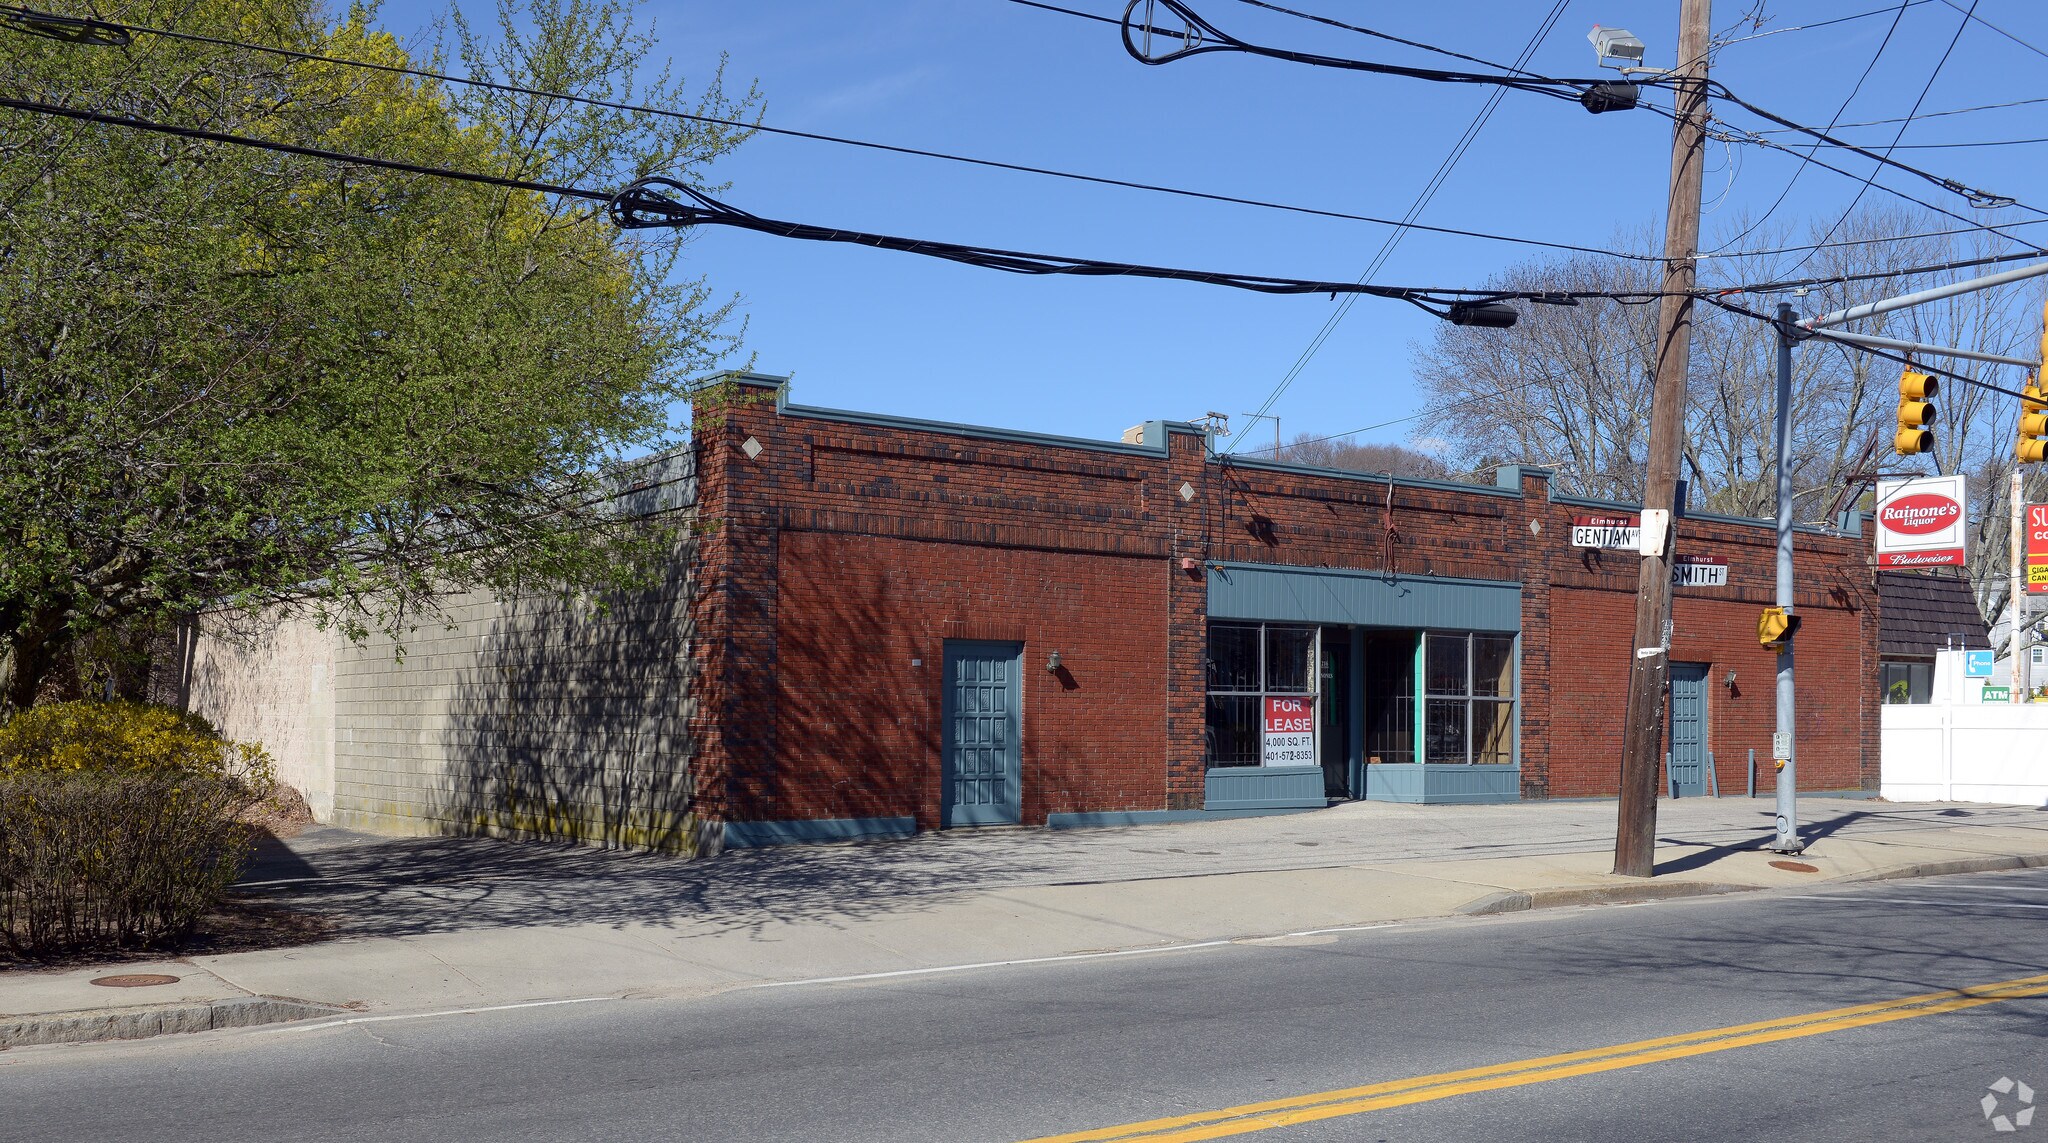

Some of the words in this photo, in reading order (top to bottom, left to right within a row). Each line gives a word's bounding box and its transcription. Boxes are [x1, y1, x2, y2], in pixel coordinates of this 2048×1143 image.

[1883, 502, 1958, 520] Rainone's
[1591, 517, 1627, 525] Elmhurst
[1903, 517, 1936, 527] Liquor
[1576, 528, 1631, 545] GENTIAN
[1683, 555, 1713, 563] Elmhurst
[1890, 553, 1954, 565] Budweiser
[1673, 566, 1718, 583] SMITH
[1983, 690, 2008, 700] ATM
[1273, 699, 1302, 712] FOR
[1265, 718, 1312, 731] LEASE
[1266, 737, 1286, 748] 4,000
[1287, 736, 1300, 746] SQ.
[1301, 736, 1312, 746] FT.
[1265, 750, 1313, 761] 401-572-8353
